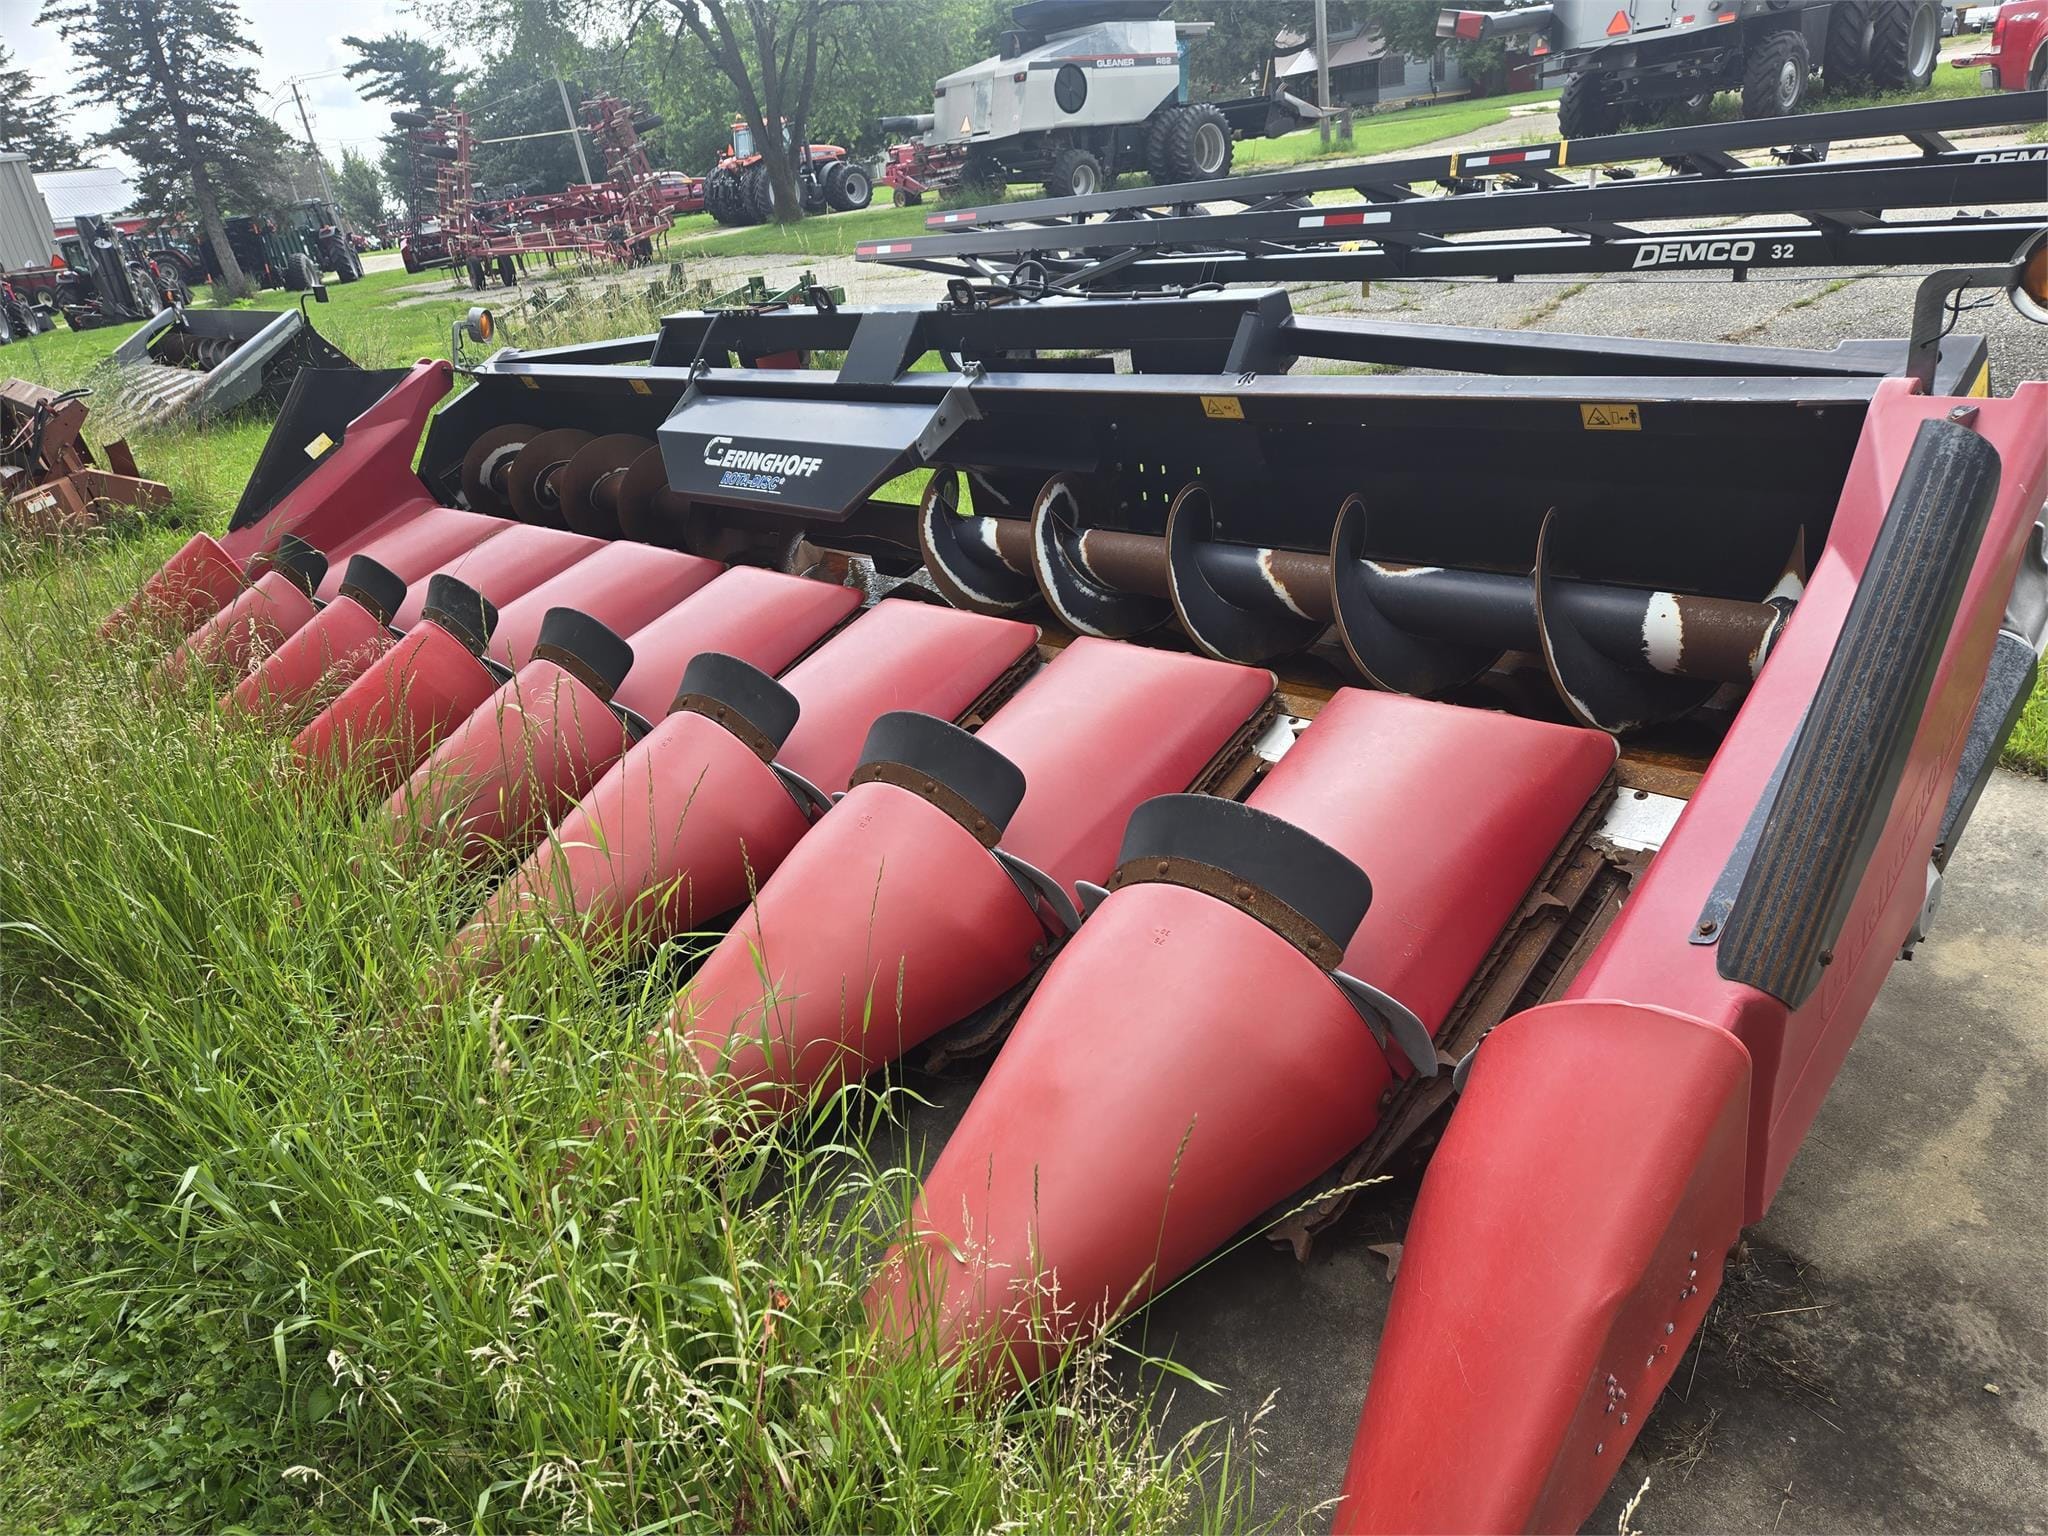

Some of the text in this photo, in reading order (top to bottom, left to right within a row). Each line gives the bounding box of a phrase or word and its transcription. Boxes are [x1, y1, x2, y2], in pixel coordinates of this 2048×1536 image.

[1096, 58, 1135, 68] GLEANER
[1632, 240, 1794, 269] DEMCO 32
[703, 436, 823, 477] GERINGHOFF
